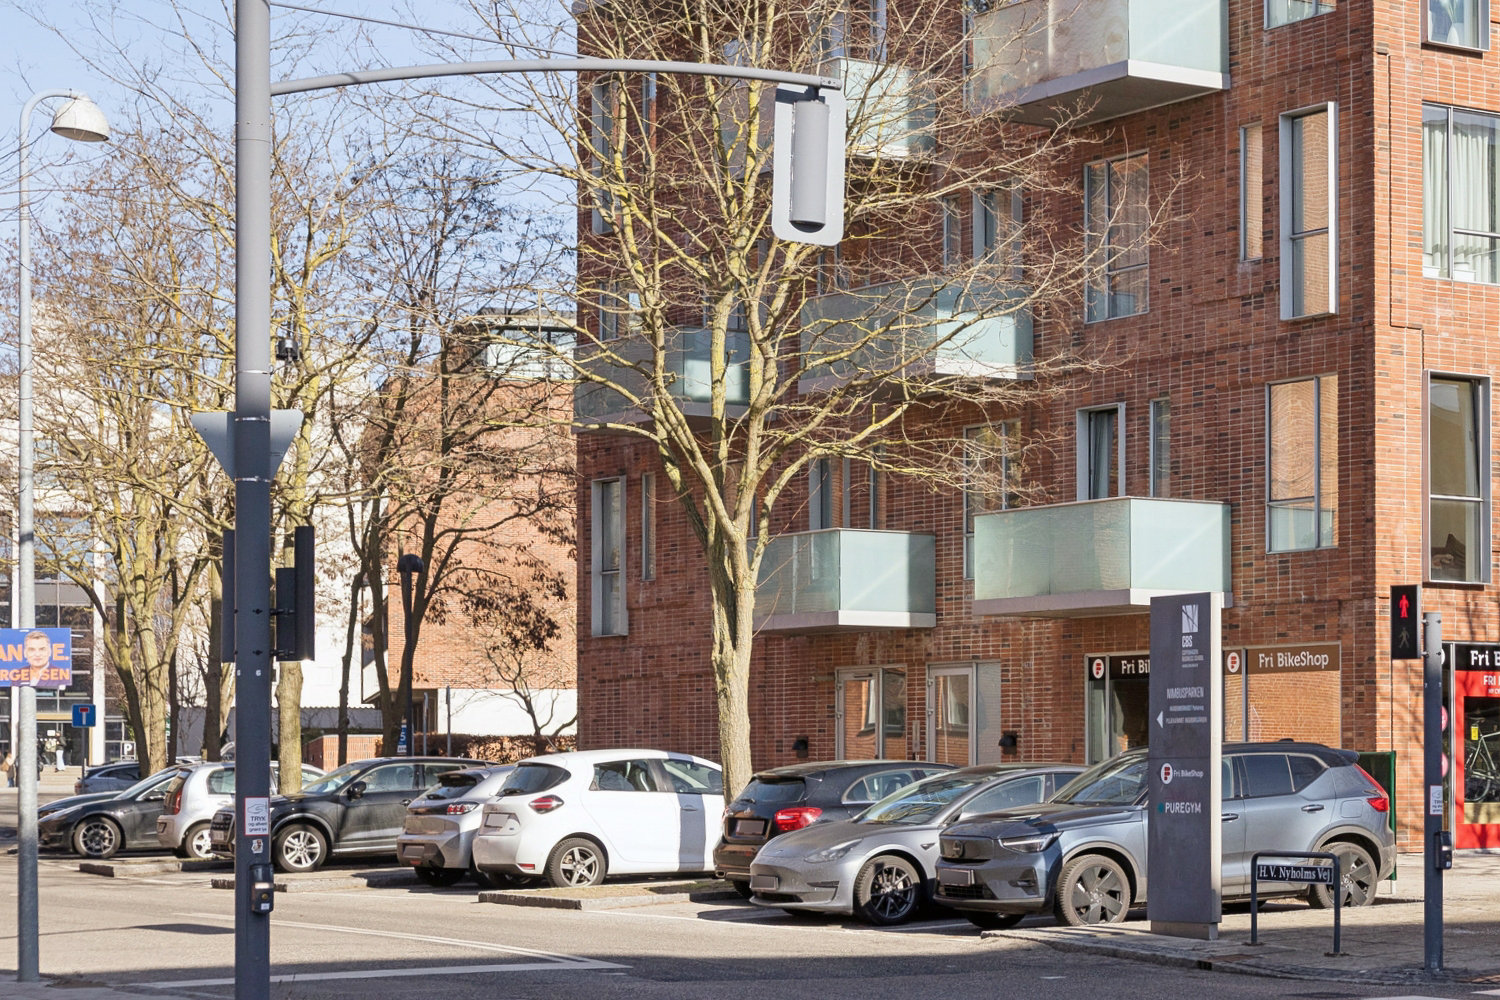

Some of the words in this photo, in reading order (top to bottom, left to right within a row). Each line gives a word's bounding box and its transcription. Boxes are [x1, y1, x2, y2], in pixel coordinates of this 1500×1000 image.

[52, 643, 69, 661] E.
[1258, 653, 1274, 668] Fri
[1277, 651, 1329, 669] BikeShop
[1470, 650, 1489, 666] Fri
[1121, 660, 1135, 674] Fri
[1483, 675, 1496, 686] FRI
[1165, 802, 1201, 813] PUREGYM
[1279, 867, 1316, 881] Nyholms
[1317, 868, 1330, 883] Vej
